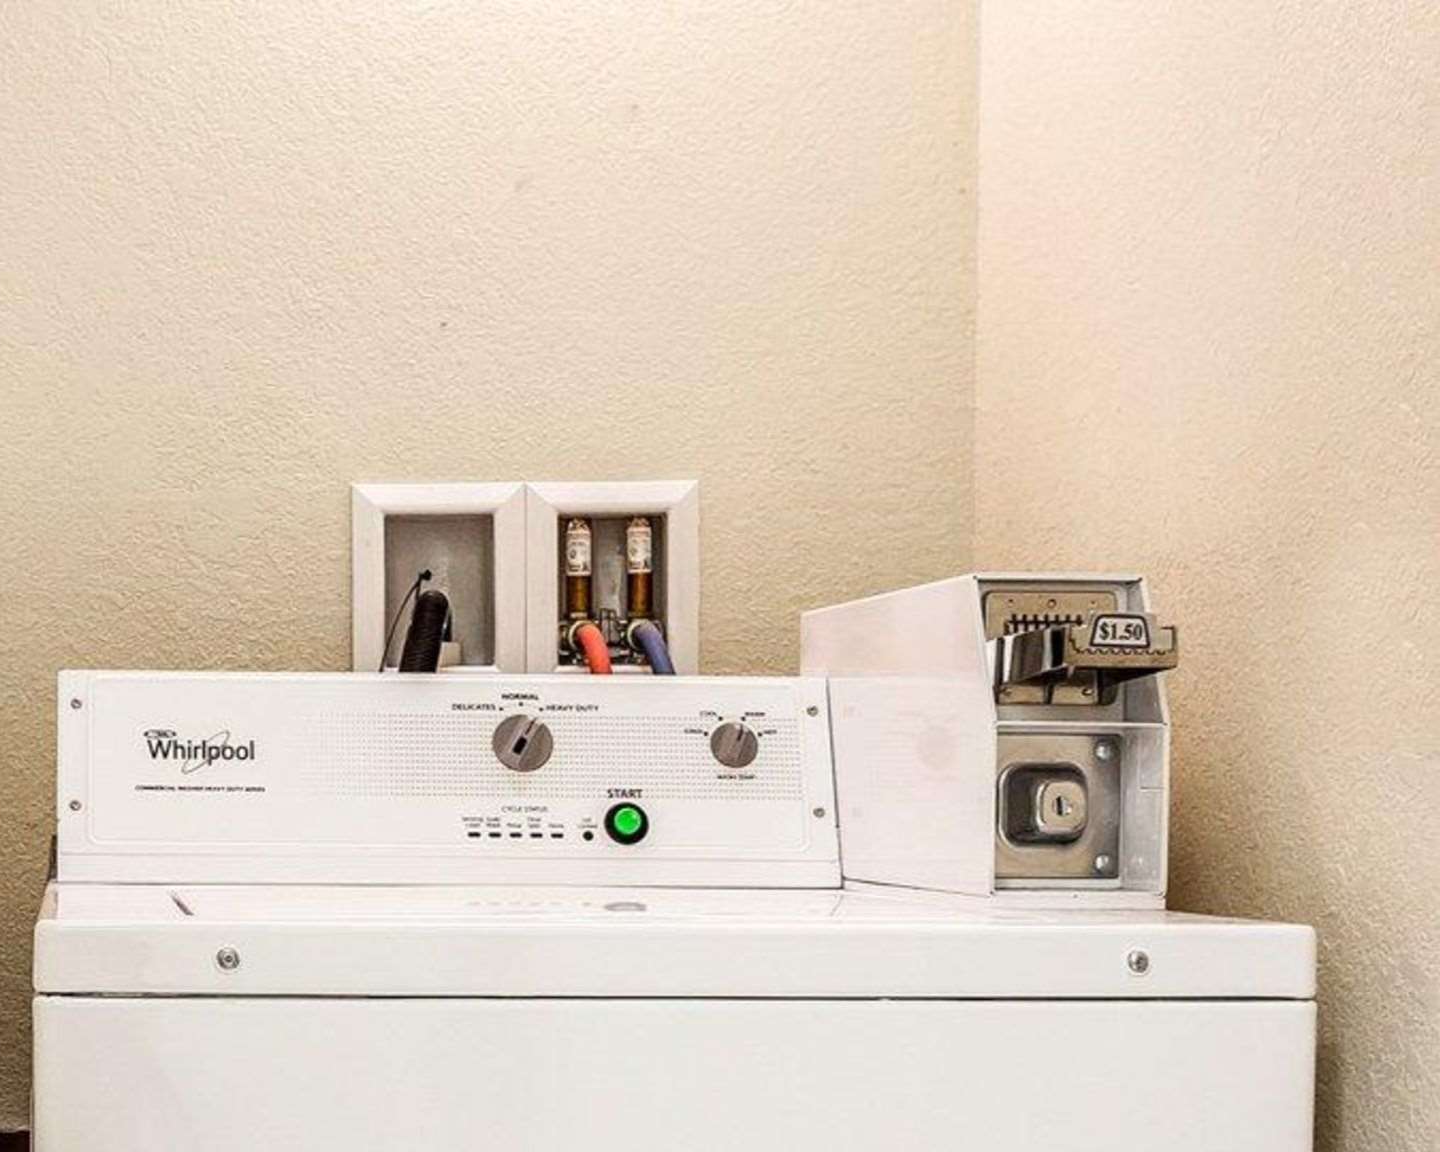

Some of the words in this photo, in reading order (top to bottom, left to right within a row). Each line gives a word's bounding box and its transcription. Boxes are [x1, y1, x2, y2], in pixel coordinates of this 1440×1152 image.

[1098, 622, 1144, 641] $1.50
[501, 693, 540, 701] NORMAL
[451, 703, 497, 711] DELICATES
[146, 738, 256, 767] Whirlpool
[607, 789, 644, 799] START
